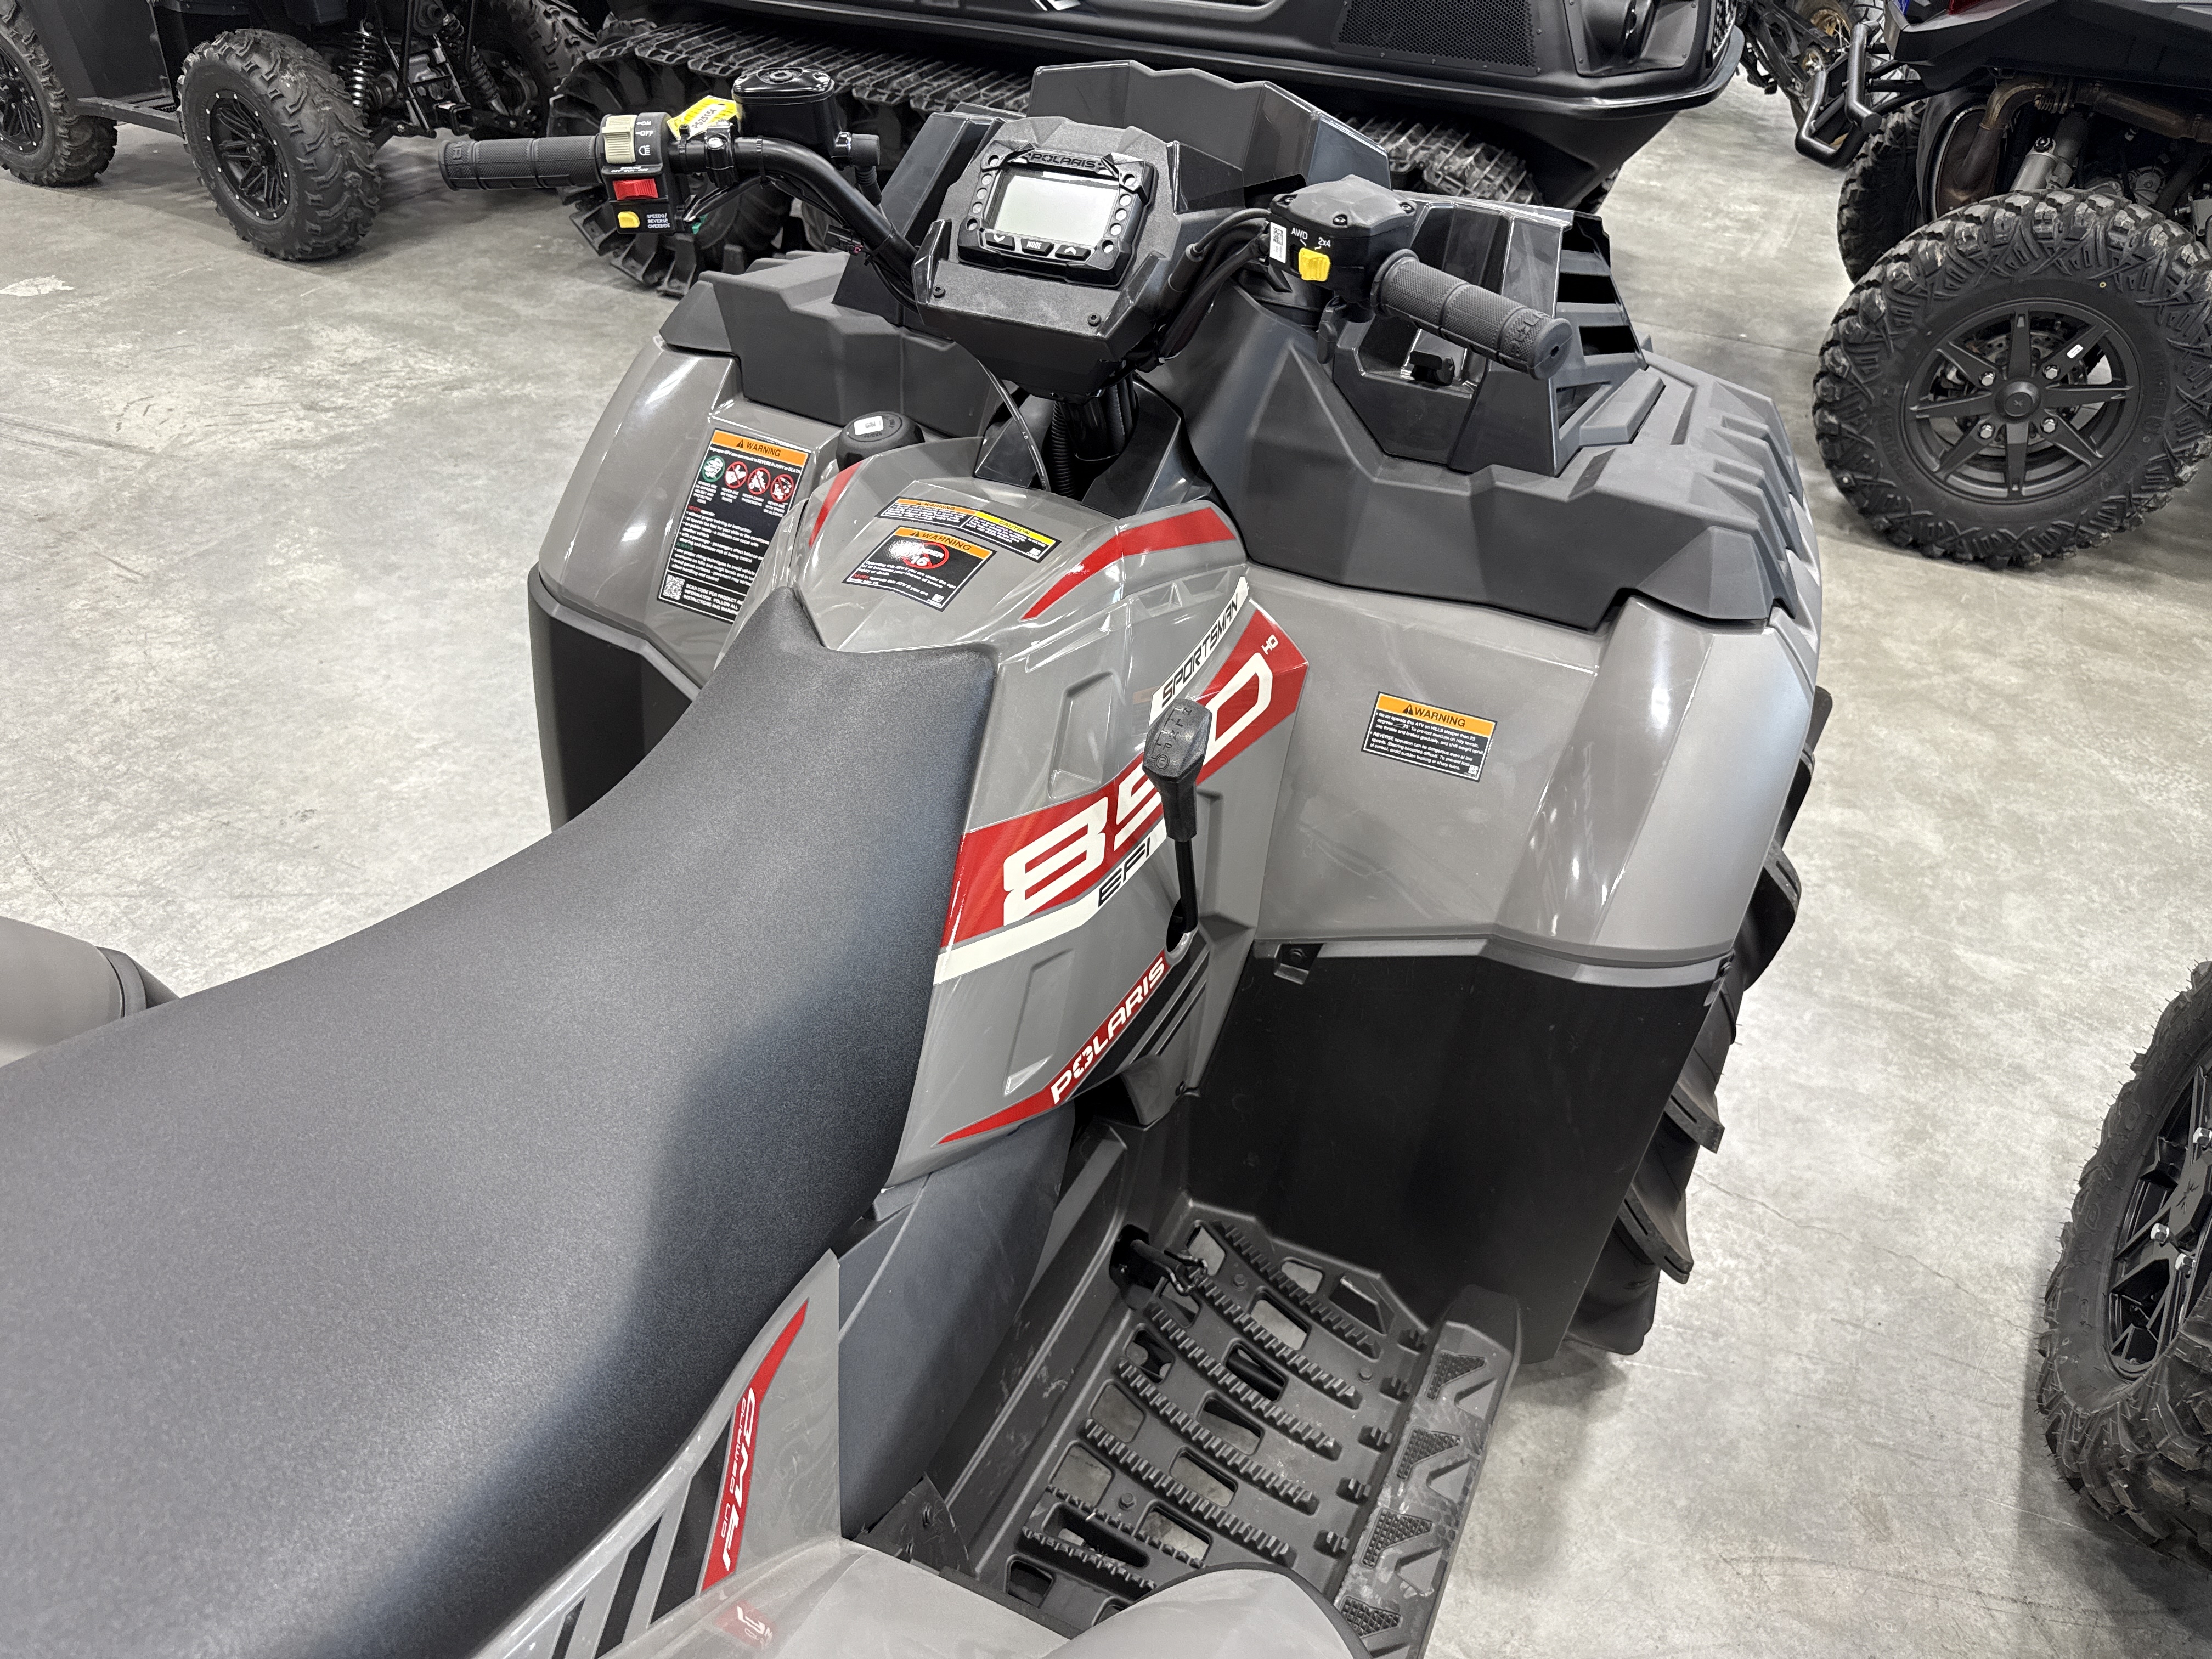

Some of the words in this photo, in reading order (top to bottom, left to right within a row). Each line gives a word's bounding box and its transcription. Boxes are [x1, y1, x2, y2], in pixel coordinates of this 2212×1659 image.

[692, 109, 717, 128] PS25154
[1031, 153, 1096, 168] POLARIS
[1290, 227, 1308, 240] AWD
[1026, 240, 1042, 250] MODE
[746, 441, 781, 457] WARNING
[924, 503, 956, 511] WARNING
[998, 521, 1030, 535] CAUTION
[921, 532, 972, 551] WARNING
[910, 556, 929, 567] 16
[1161, 592, 1238, 708] SPORTSMAN
[1261, 634, 1279, 655] HO
[1175, 718, 1183, 727] L
[1415, 707, 1466, 727] WARNING
[1098, 836, 1150, 909] EFI
[1051, 956, 1165, 1104] POLARIS
[729, 1397, 746, 1494] DEMAND
